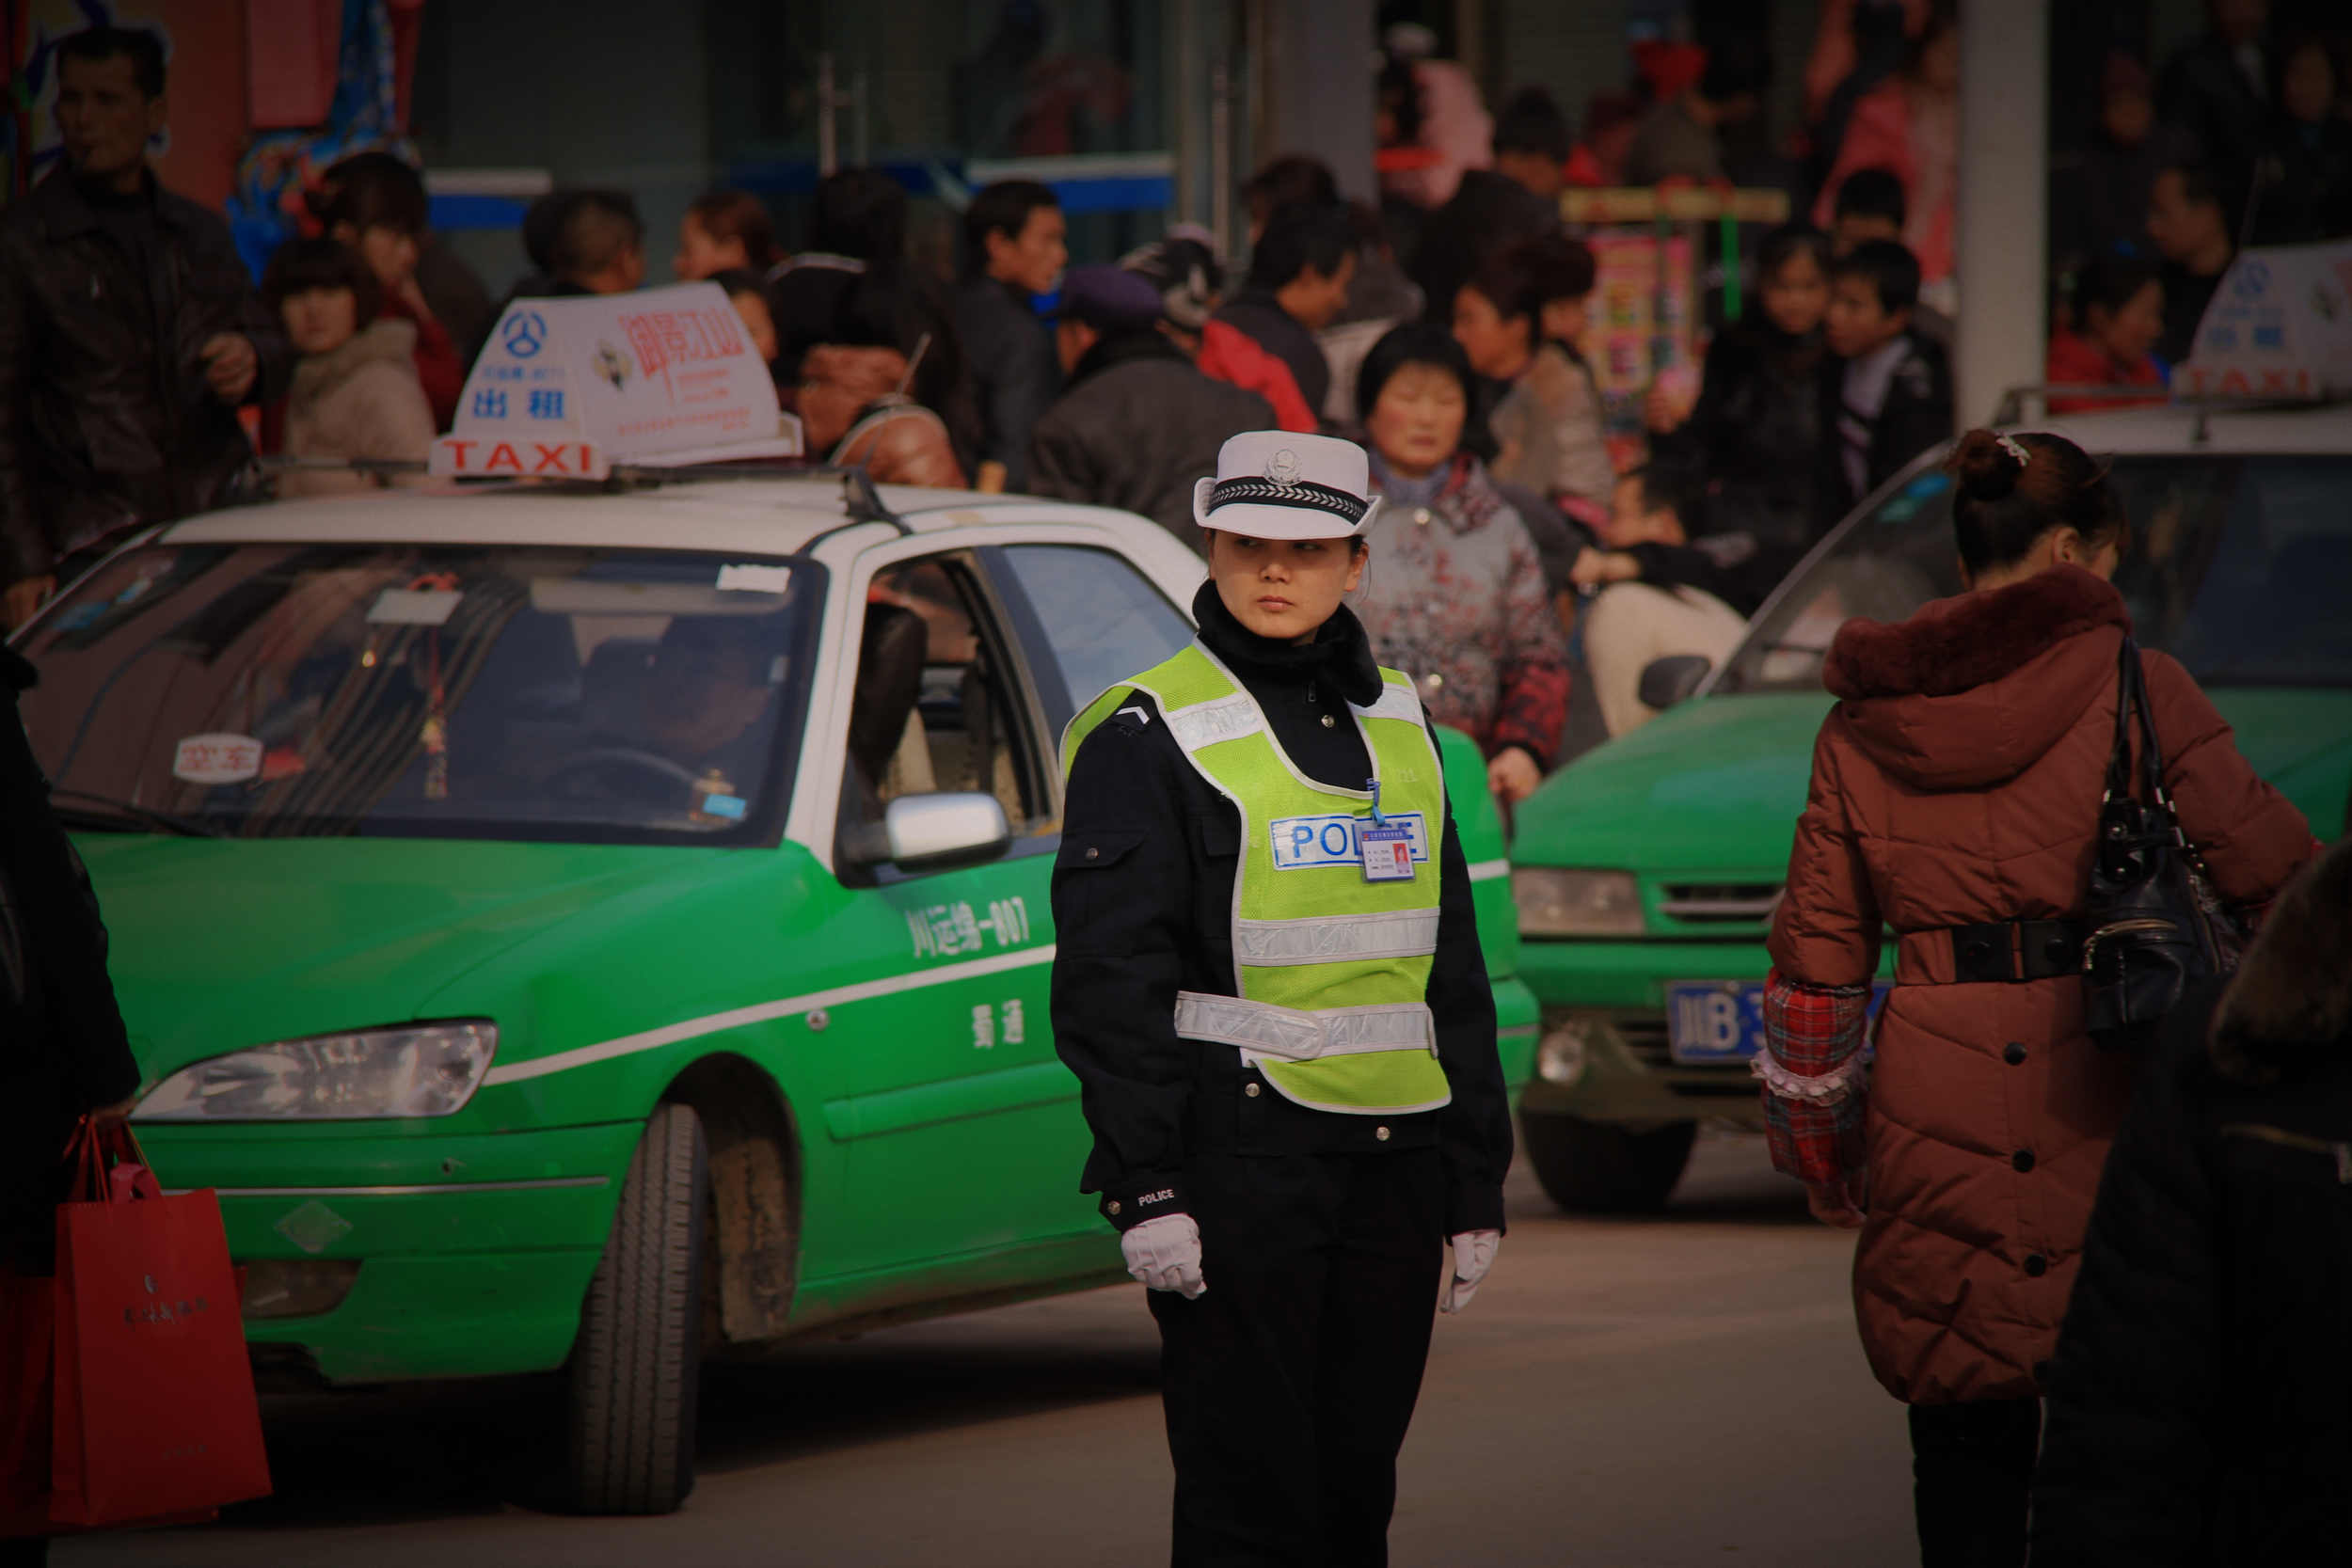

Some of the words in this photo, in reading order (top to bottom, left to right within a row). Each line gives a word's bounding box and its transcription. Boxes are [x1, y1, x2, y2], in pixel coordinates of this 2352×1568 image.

[2190, 368, 2311, 396] TAXI
[442, 440, 592, 471] TAXI
[1292, 821, 1417, 859] POLE
[1137, 1188, 1175, 1208] POLICE
